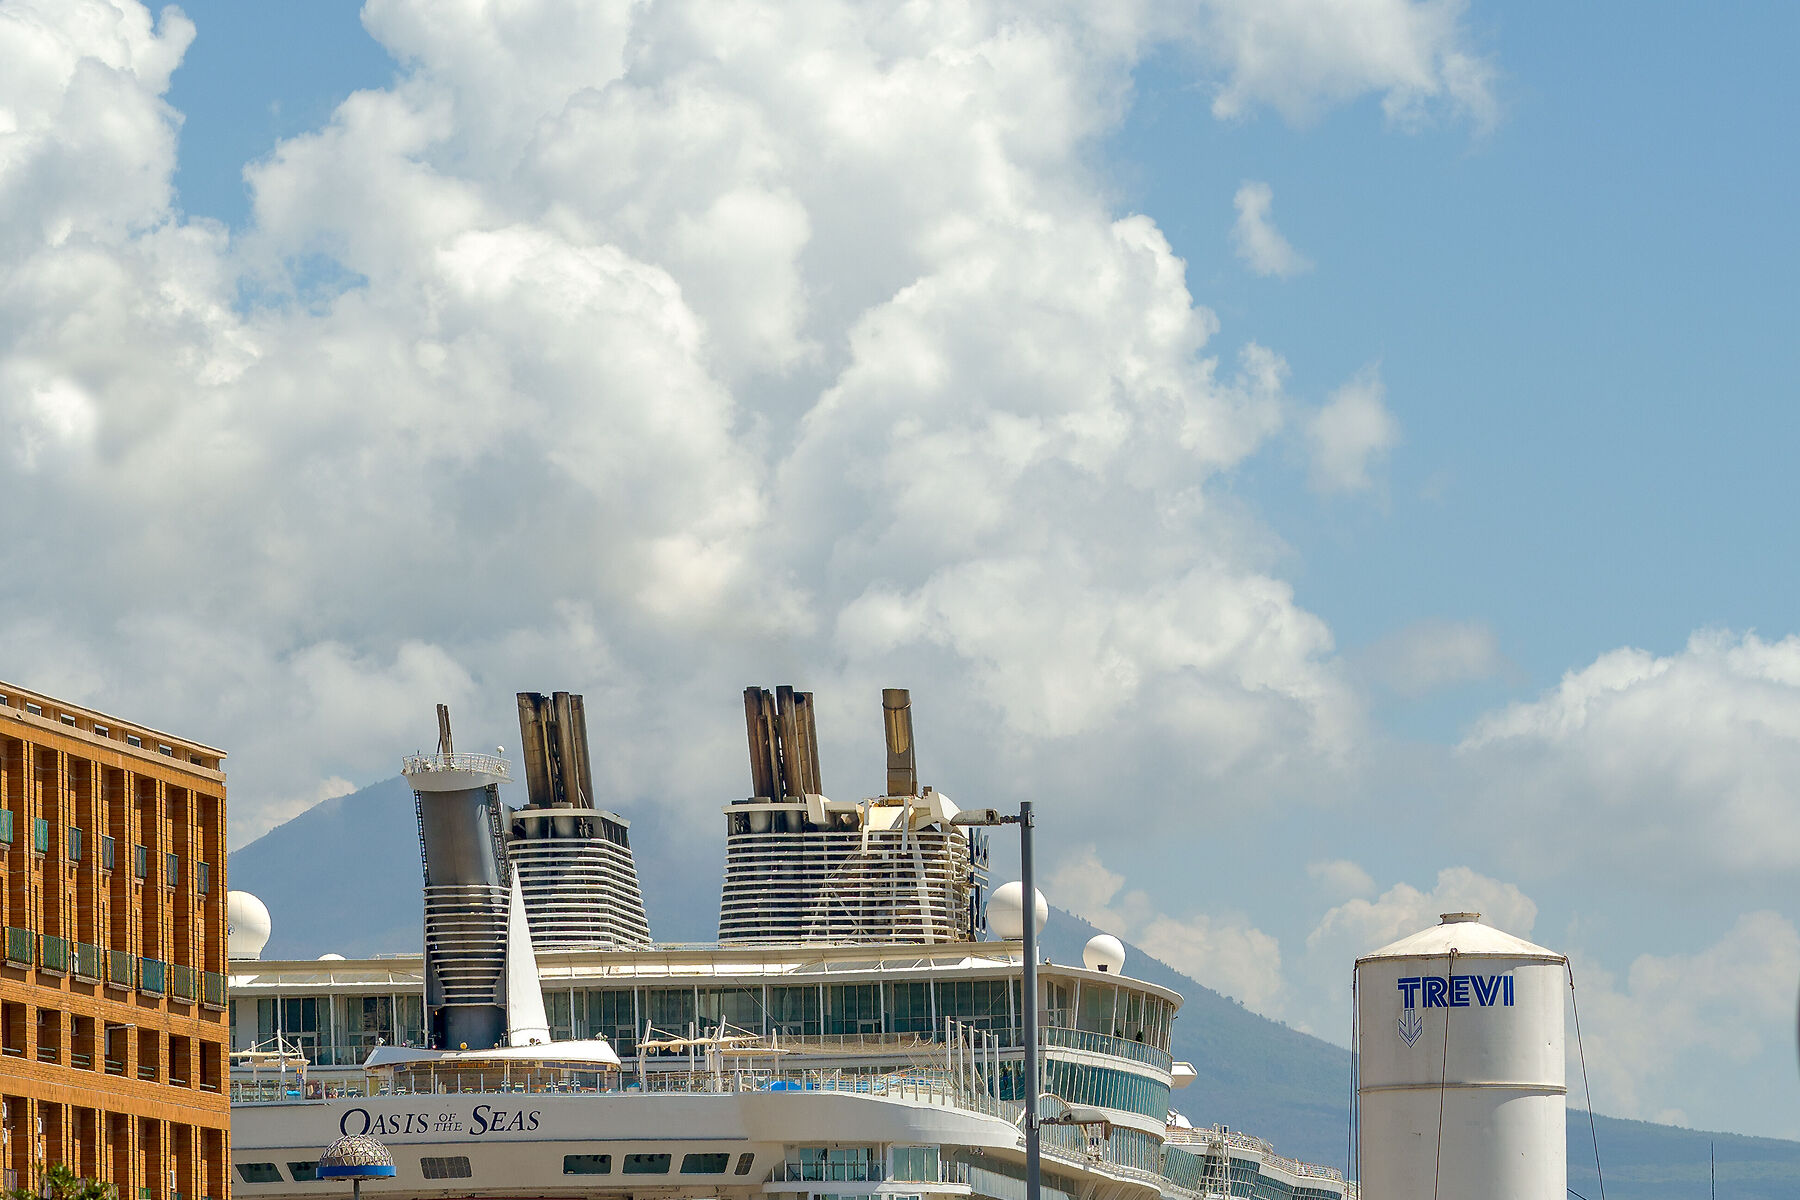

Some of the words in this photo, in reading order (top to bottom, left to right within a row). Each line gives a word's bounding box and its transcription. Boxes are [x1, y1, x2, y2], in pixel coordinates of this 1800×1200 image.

[1398, 975, 1514, 1008] TREVI
[340, 1108, 429, 1136] OASIS
[433, 1122, 463, 1132] THE
[439, 1113, 457, 1122] OF
[469, 1105, 541, 1135] SEAS
